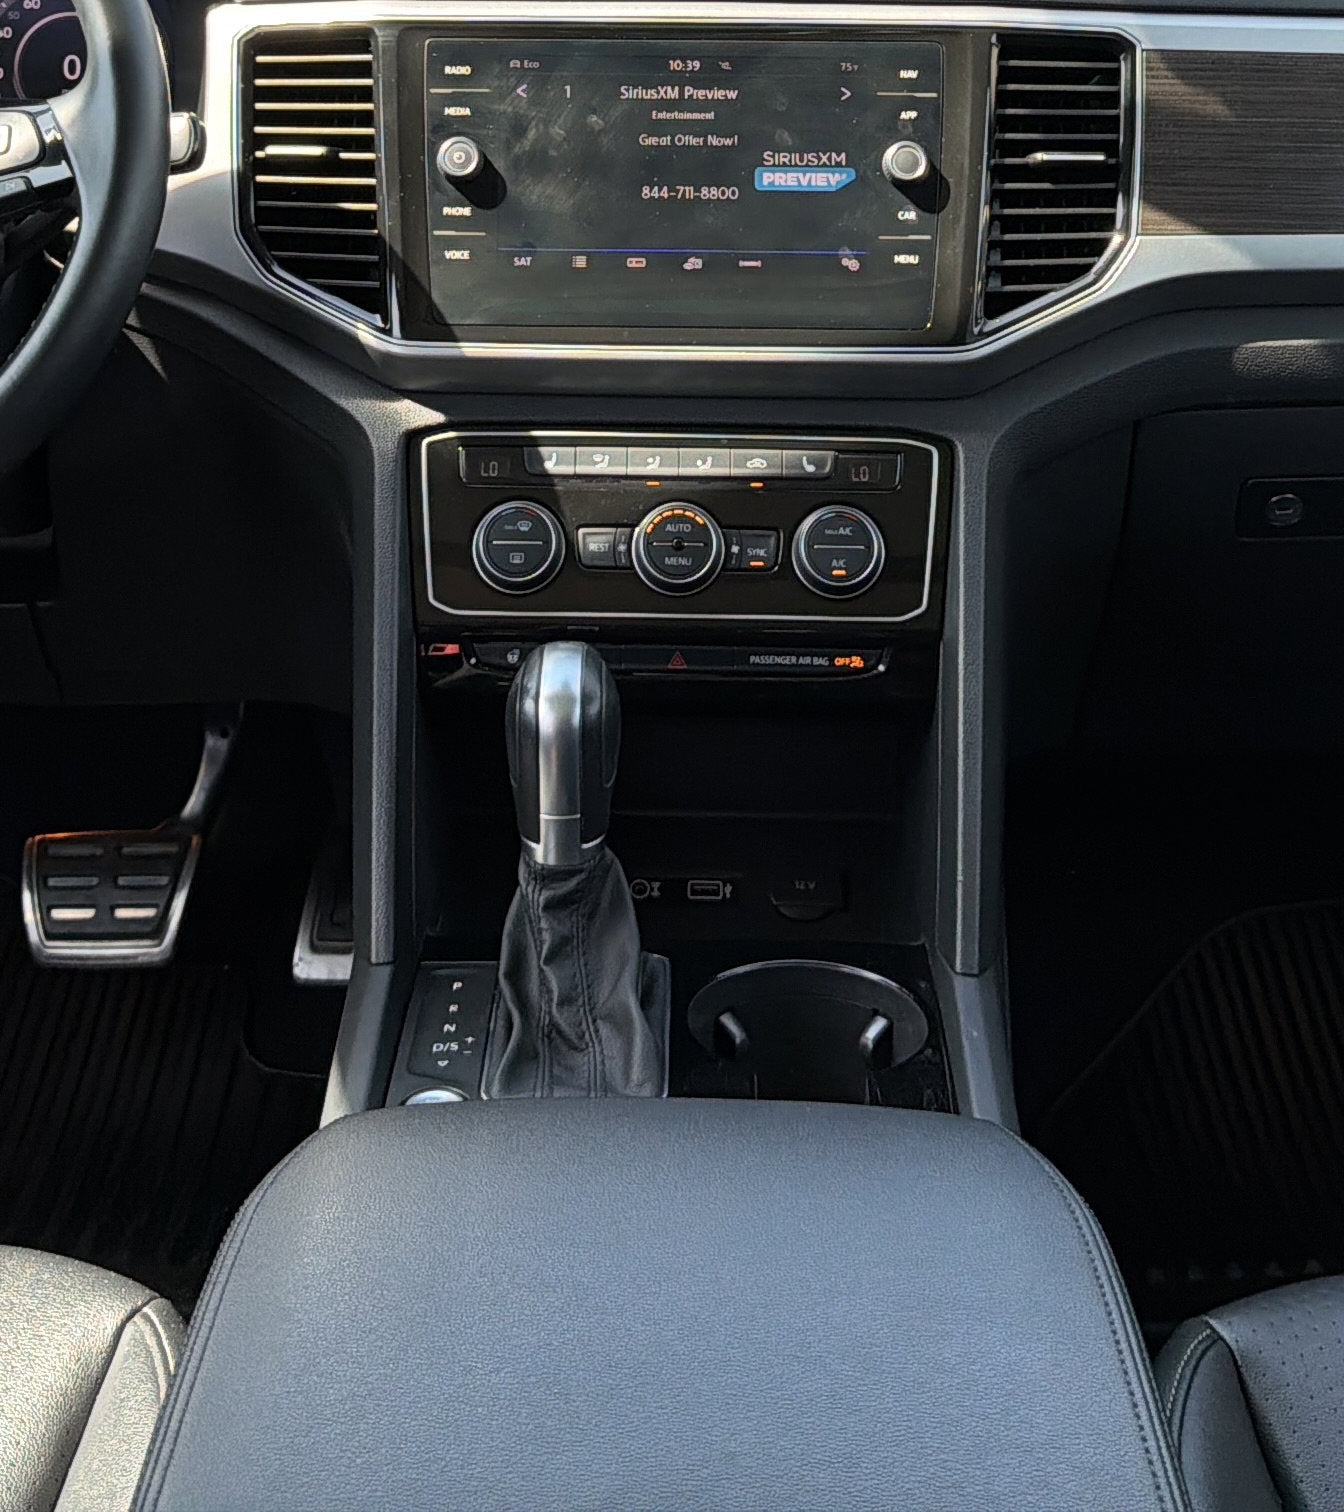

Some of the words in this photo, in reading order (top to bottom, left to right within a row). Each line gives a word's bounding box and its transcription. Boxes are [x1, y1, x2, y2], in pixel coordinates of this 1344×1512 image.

[63, 55, 81, 80] 0
[523, 60, 540, 69] Eco
[668, 59, 701, 71] 10:39
[444, 66, 472, 75] RADIO
[900, 70, 918, 78] NAV
[564, 85, 572, 99] 1
[620, 86, 679, 99] SiriusXM
[684, 86, 739, 100] Preview
[444, 107, 472, 117] MEDIA
[651, 110, 715, 120] Entertainment
[899, 111, 918, 119] APP
[638, 134, 672, 146] Great
[674, 134, 704, 146] Offer
[707, 134, 739, 146] Now!
[762, 151, 847, 166] SIRIUSXM
[762, 172, 846, 186] PREVIEW
[641, 186, 739, 200] 844-711-8800
[442, 207, 472, 216] PHONE
[897, 211, 917, 220] CAR
[444, 250, 470, 260] VOICE
[893, 254, 919, 264] MENU
[513, 257, 532, 266] SAT
[665, 523, 692, 533] AUTO
[588, 542, 609, 552] REST
[746, 548, 768, 557] SYNC
[664, 556, 692, 566] MENU
[831, 558, 846, 568] A/C
[749, 655, 796, 665] PASSENGER
[798, 655, 811, 665] AIR
[812, 656, 829, 666] BAG
[834, 656, 850, 667] OFF
[453, 981, 463, 992] P
[449, 1004, 459, 1014] R
[443, 1023, 456, 1033] N
[432, 1042, 459, 1054] D/S
